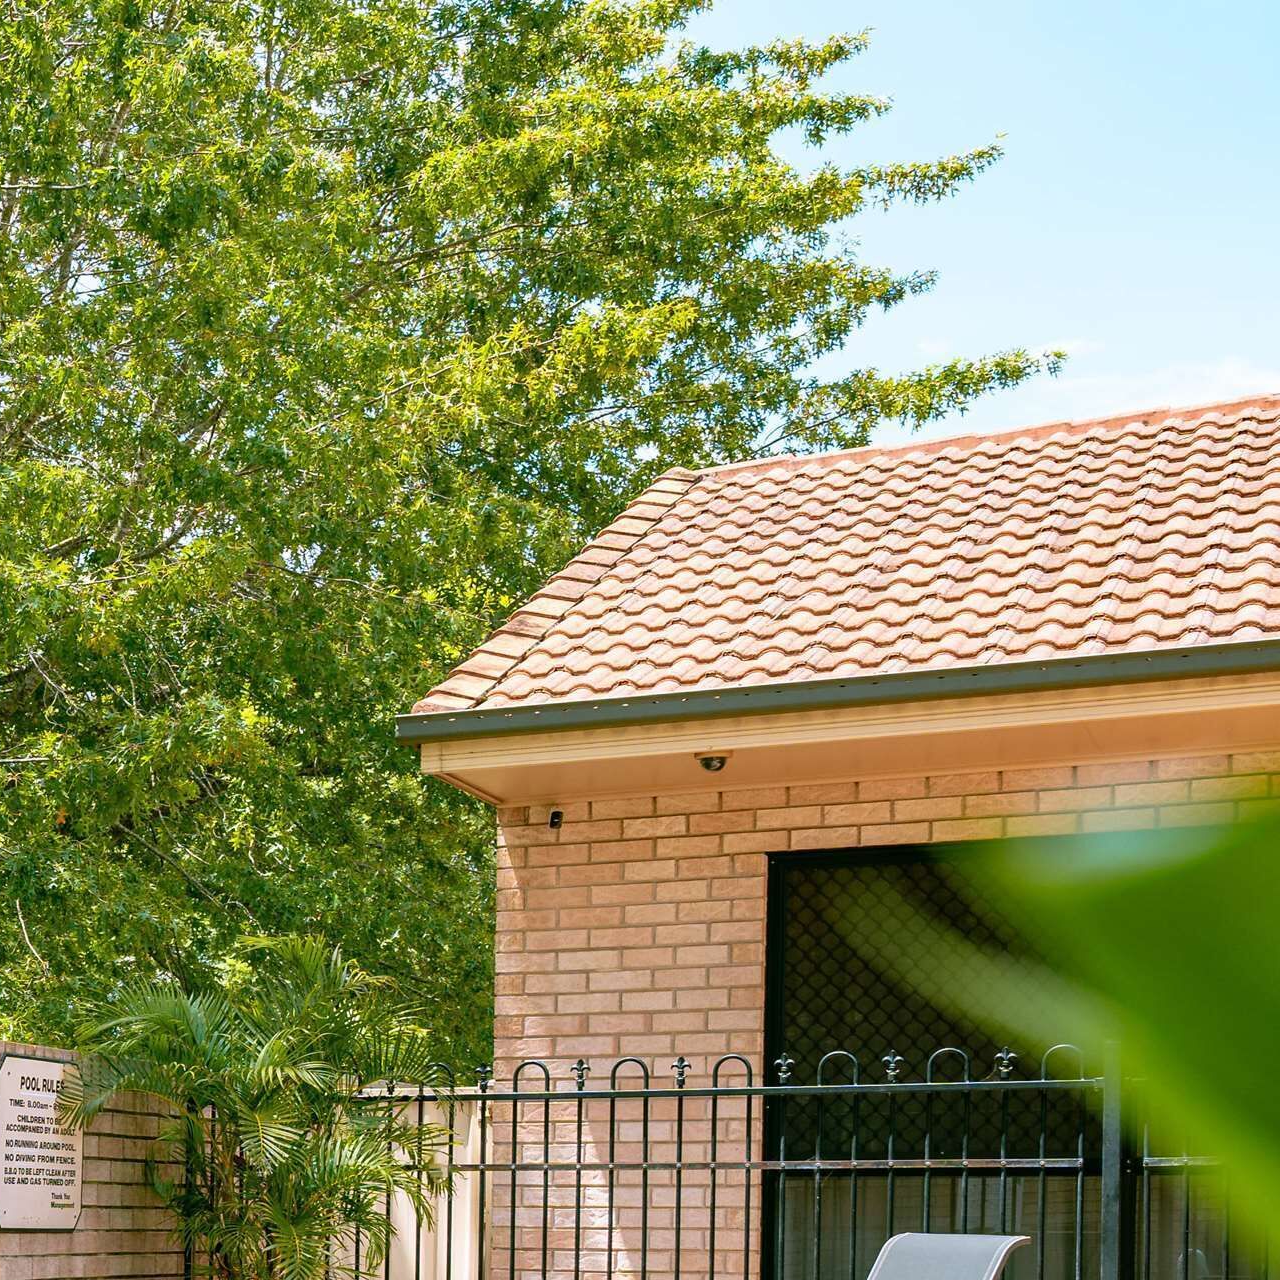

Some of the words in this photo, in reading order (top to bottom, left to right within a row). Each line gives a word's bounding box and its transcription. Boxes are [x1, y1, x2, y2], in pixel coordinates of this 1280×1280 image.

[20, 1076, 40, 1091] POOL
[42, 1079, 65, 1093] RULES
[9, 1099, 25, 1107] TIME:
[28, 1100, 48, 1109] 8.00am
[17, 1115, 45, 1124] CHILDREN
[6, 1124, 43, 1133] ACCOMPANIED
[5, 1139, 13, 1147] NO
[14, 1139, 38, 1148] RUNNING
[39, 1141, 60, 1150] AROUND
[61, 1143, 76, 1151] POOL.
[15, 1154, 35, 1162] DIVING
[37, 1155, 55, 1163] FROM
[56, 1156, 76, 1164] FENCE.
[33, 1168, 45, 1176] LEFT
[30, 1177, 41, 1185] GAS
[43, 1178, 63, 1186] TURNED
